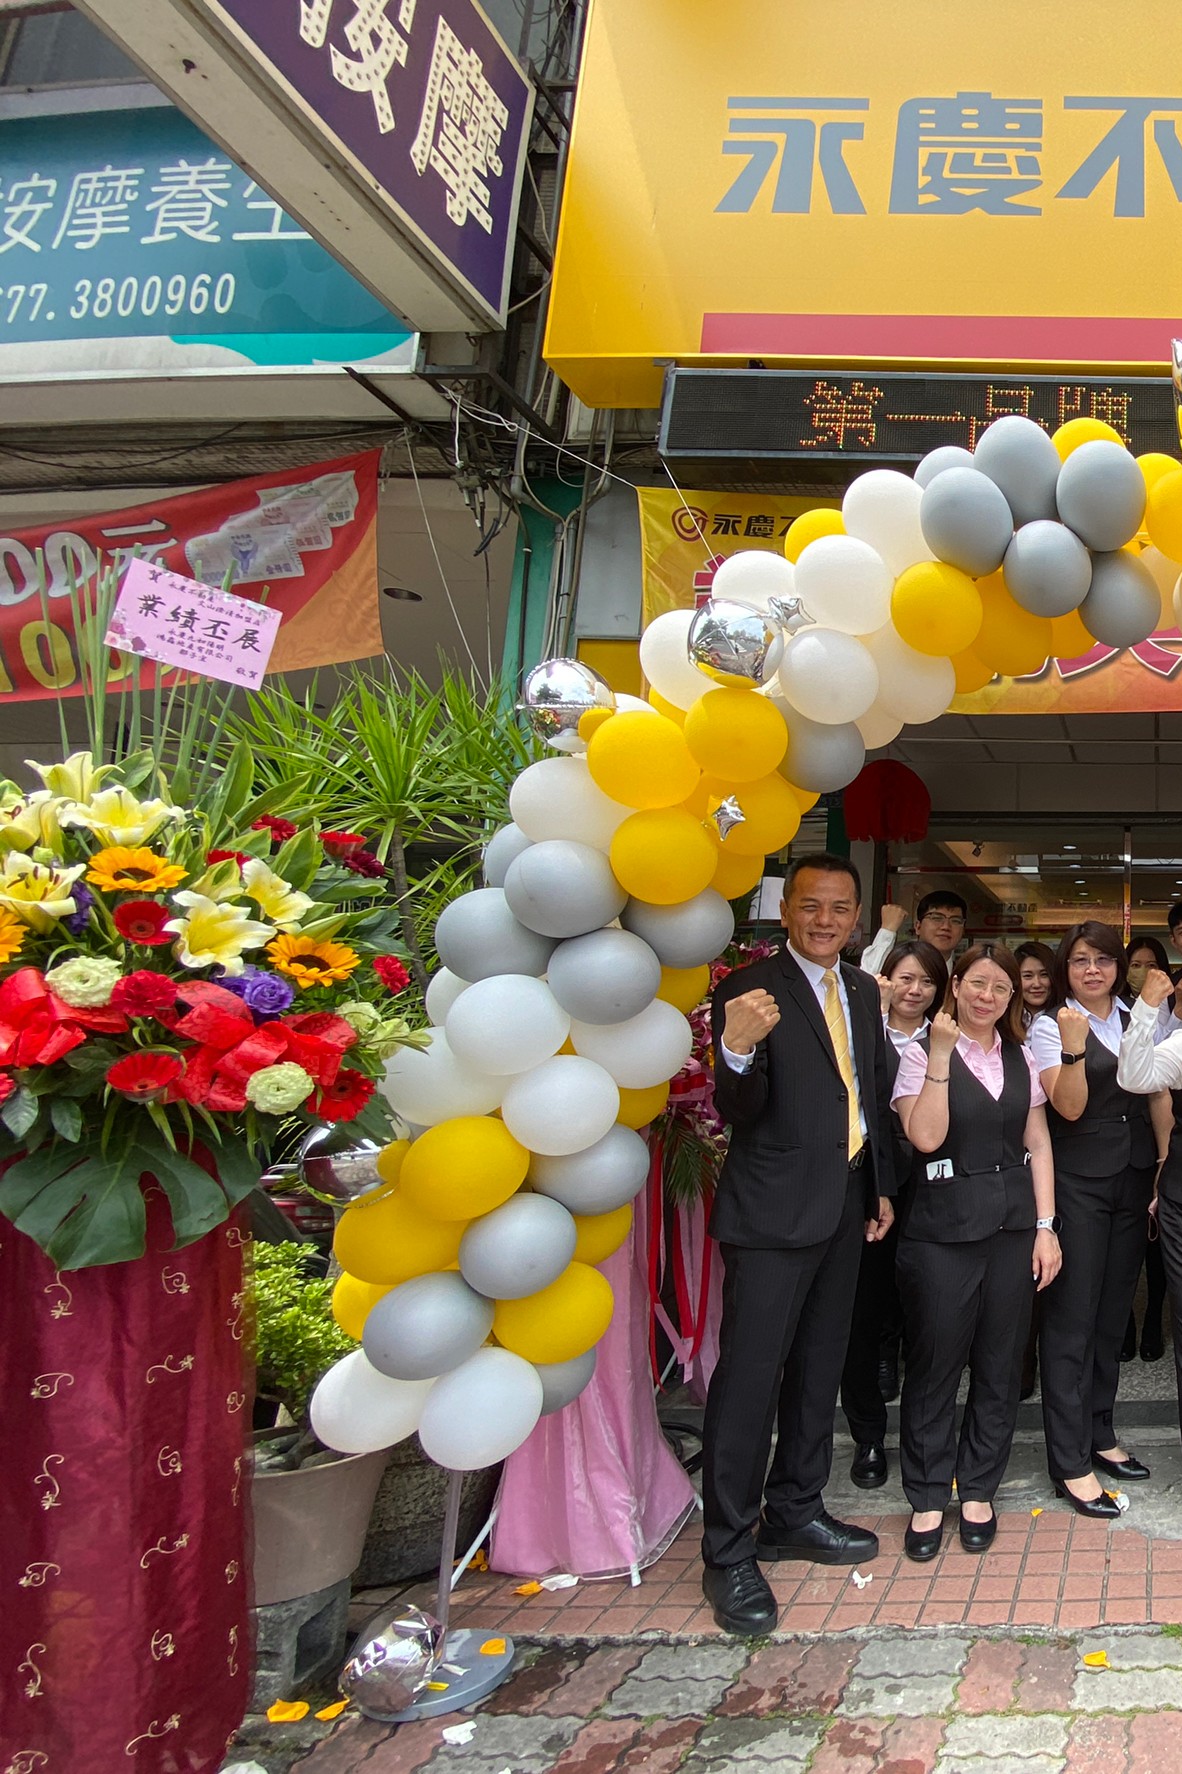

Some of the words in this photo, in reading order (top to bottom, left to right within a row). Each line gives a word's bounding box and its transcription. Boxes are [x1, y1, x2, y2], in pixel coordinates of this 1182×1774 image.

[0, 273, 235, 324] 77.3800960
[136, 594, 263, 653] 業績丕展
